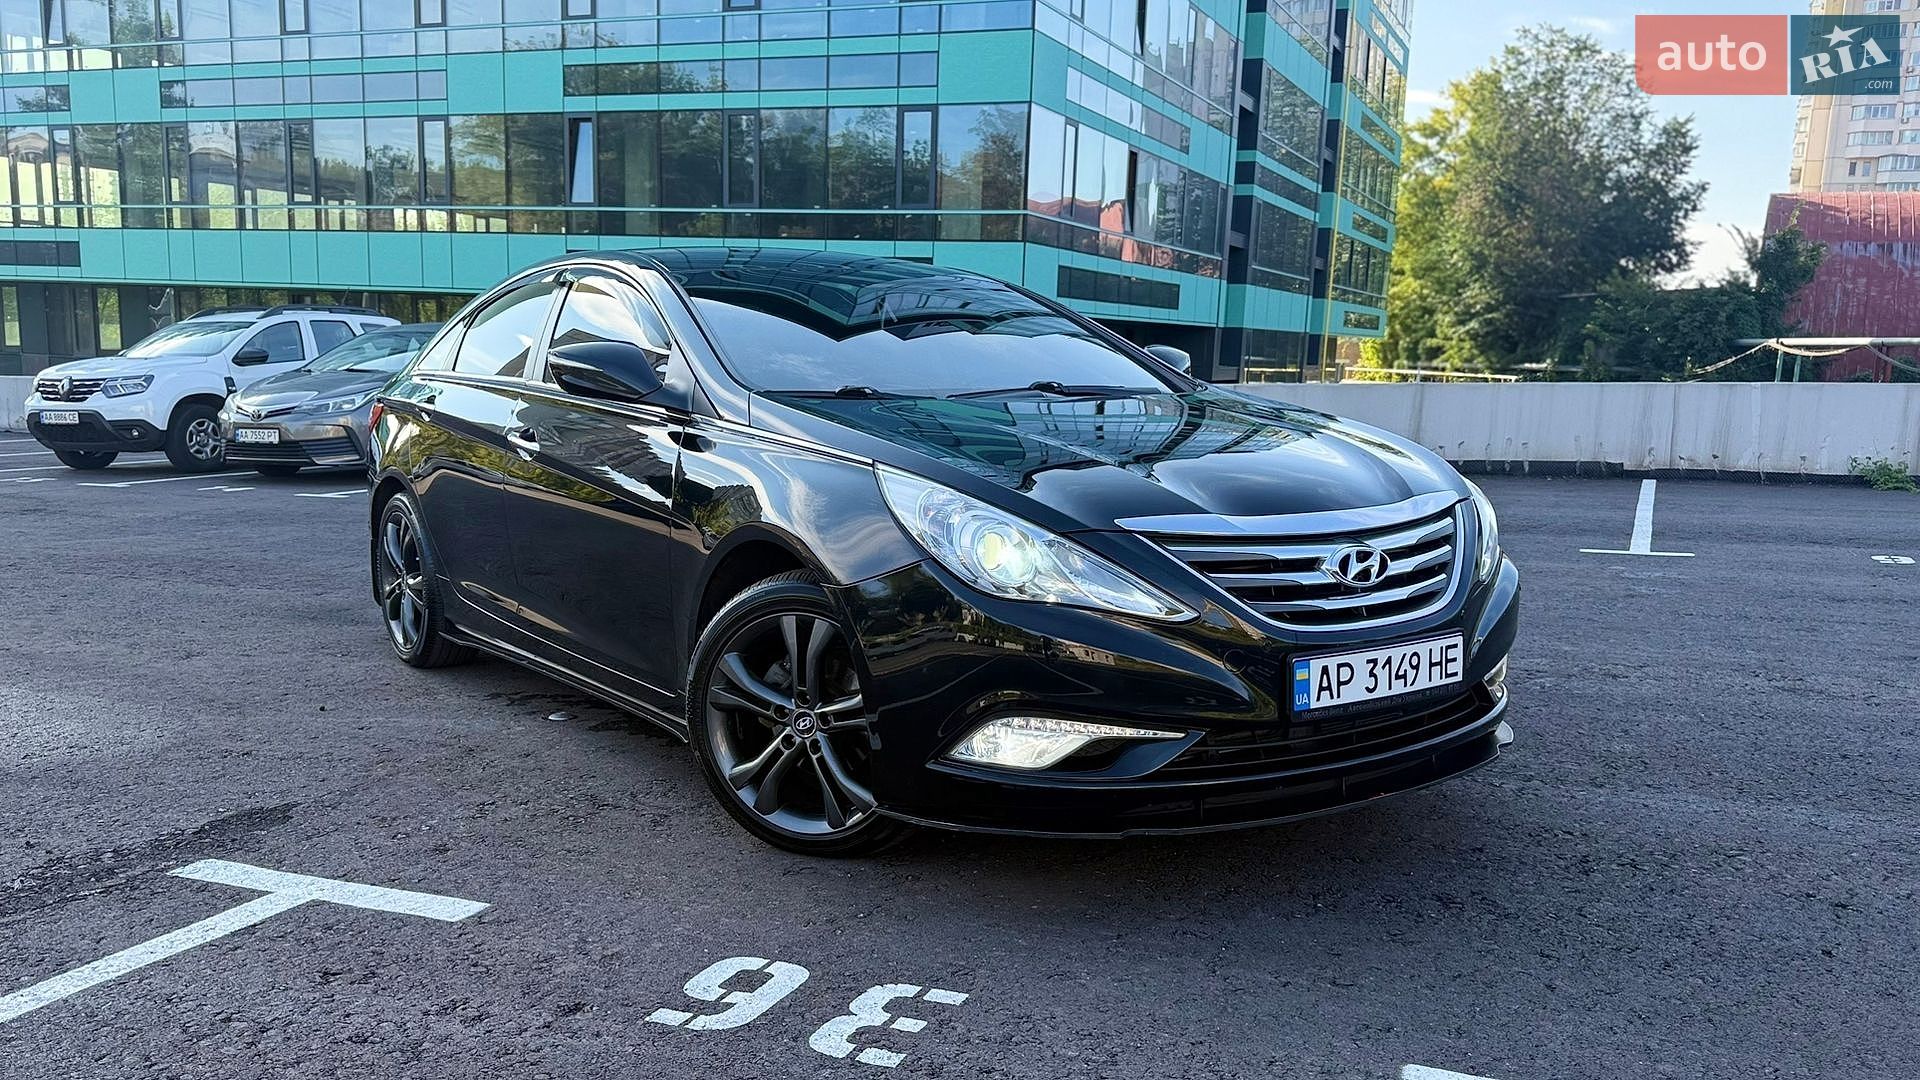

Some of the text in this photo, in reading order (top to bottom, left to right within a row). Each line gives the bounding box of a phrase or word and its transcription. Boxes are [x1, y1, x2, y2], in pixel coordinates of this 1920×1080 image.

[240, 430, 277, 441] AA 7552 PT
[1316, 643, 1459, 702] AP 3149 HE
[1295, 693, 1310, 705] UA
